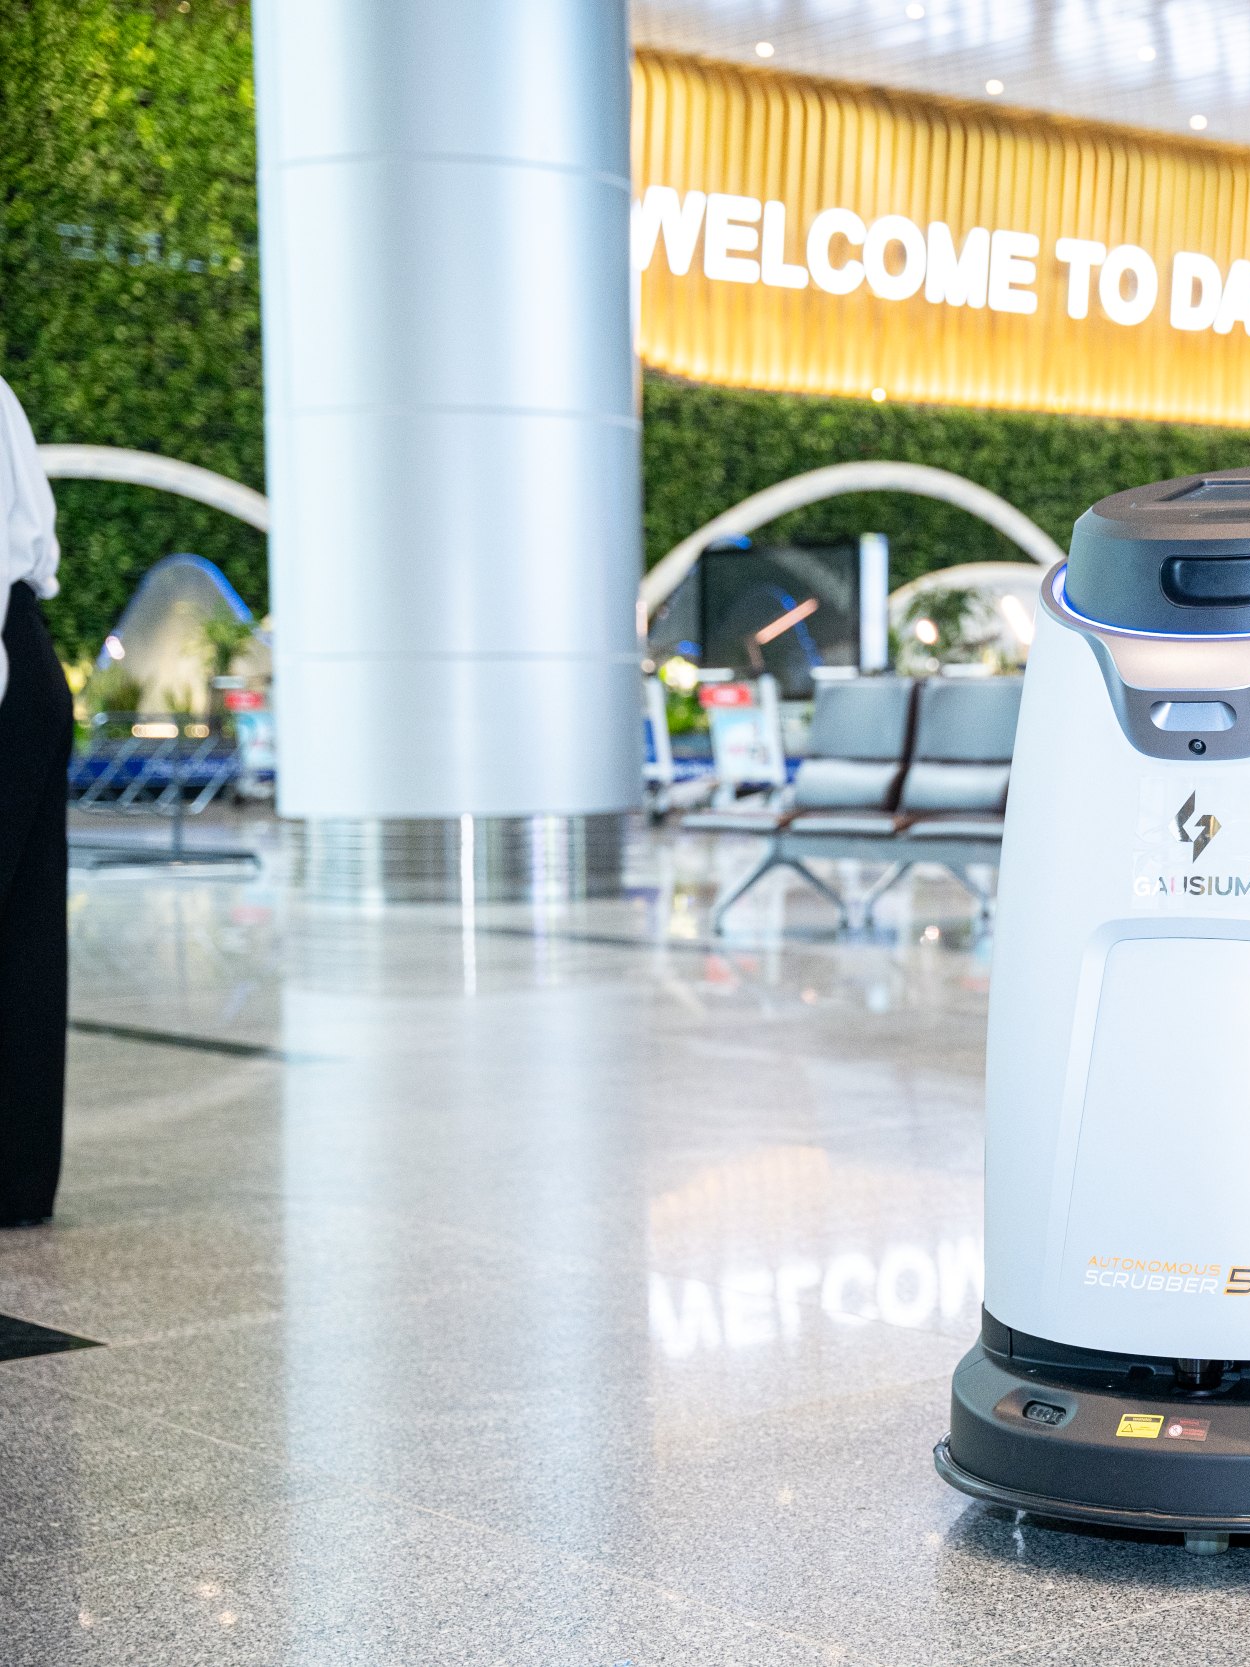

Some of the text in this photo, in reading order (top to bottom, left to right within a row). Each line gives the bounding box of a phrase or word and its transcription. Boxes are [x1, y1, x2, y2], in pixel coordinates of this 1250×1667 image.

[632, 185, 1040, 314] WELCOME
[1056, 238, 1158, 325] TO
[1088, 1255, 1221, 1277] AUTONOMOUS
[1084, 1269, 1219, 1295] SCRUBBER
